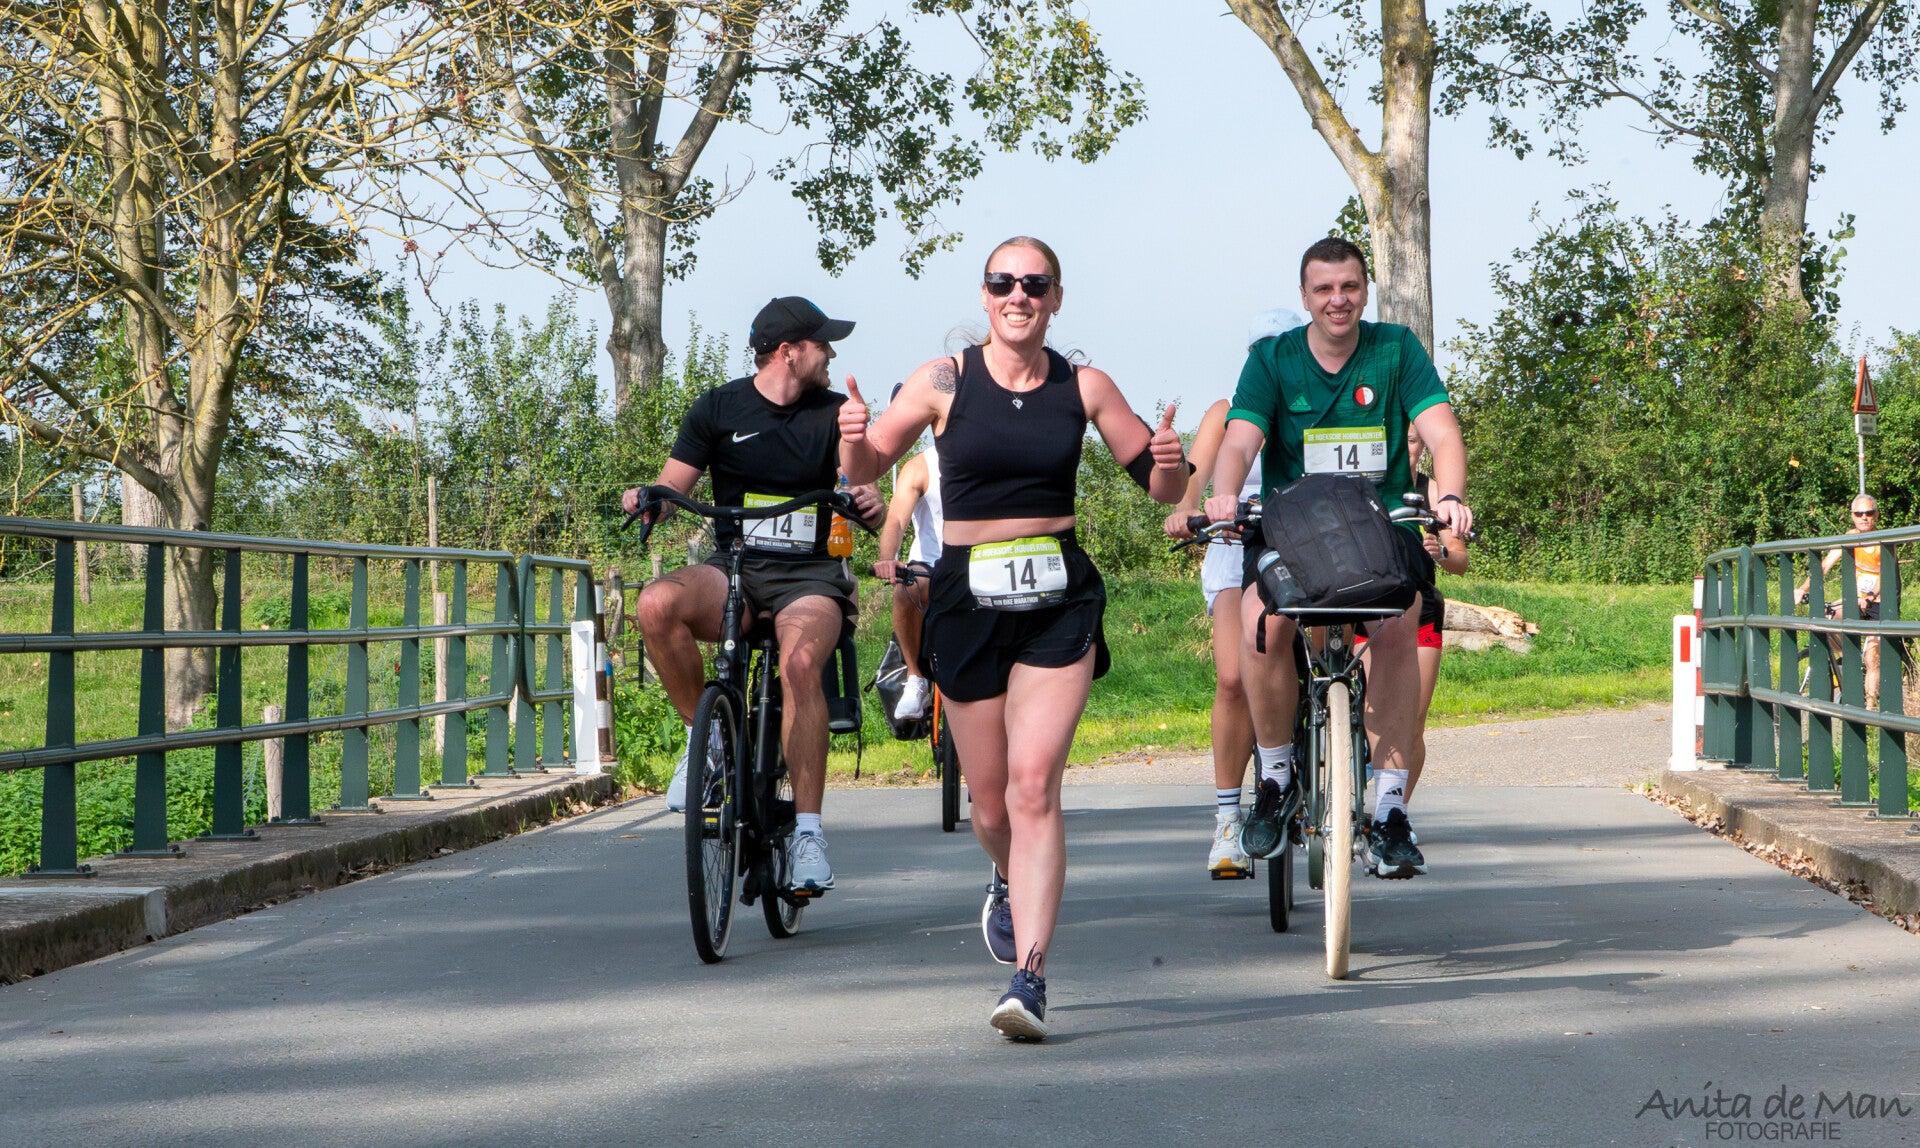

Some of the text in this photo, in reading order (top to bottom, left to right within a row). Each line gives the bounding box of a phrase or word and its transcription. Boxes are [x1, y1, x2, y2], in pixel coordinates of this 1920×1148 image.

[1334, 444, 1360, 470] 14
[772, 514, 793, 538] 14
[1004, 558, 1037, 592] 14
[1014, 596, 1039, 605] MARATHON
